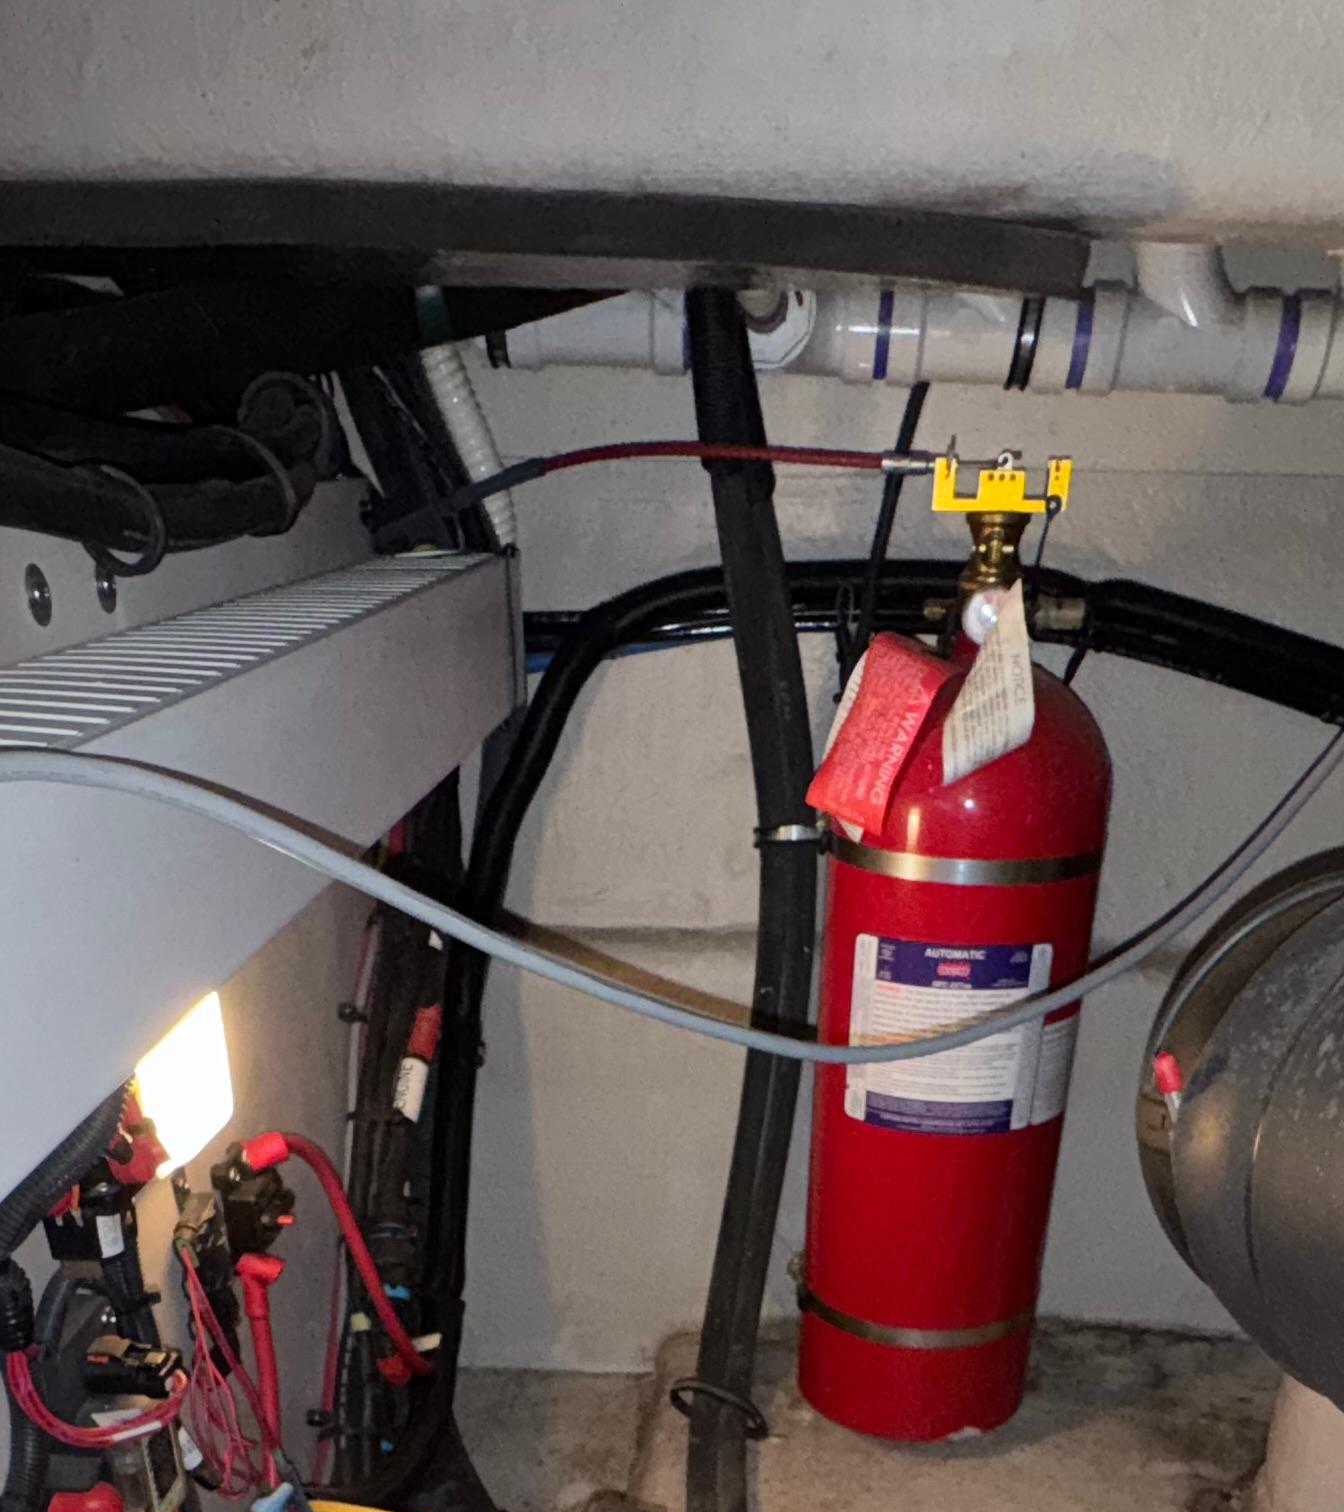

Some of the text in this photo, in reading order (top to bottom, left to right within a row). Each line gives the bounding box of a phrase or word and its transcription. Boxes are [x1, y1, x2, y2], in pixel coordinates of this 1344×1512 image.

[1009, 655, 1027, 705] NOTICE
[870, 710, 921, 805] WARNING
[925, 948, 986, 960] AUTOMATIC
